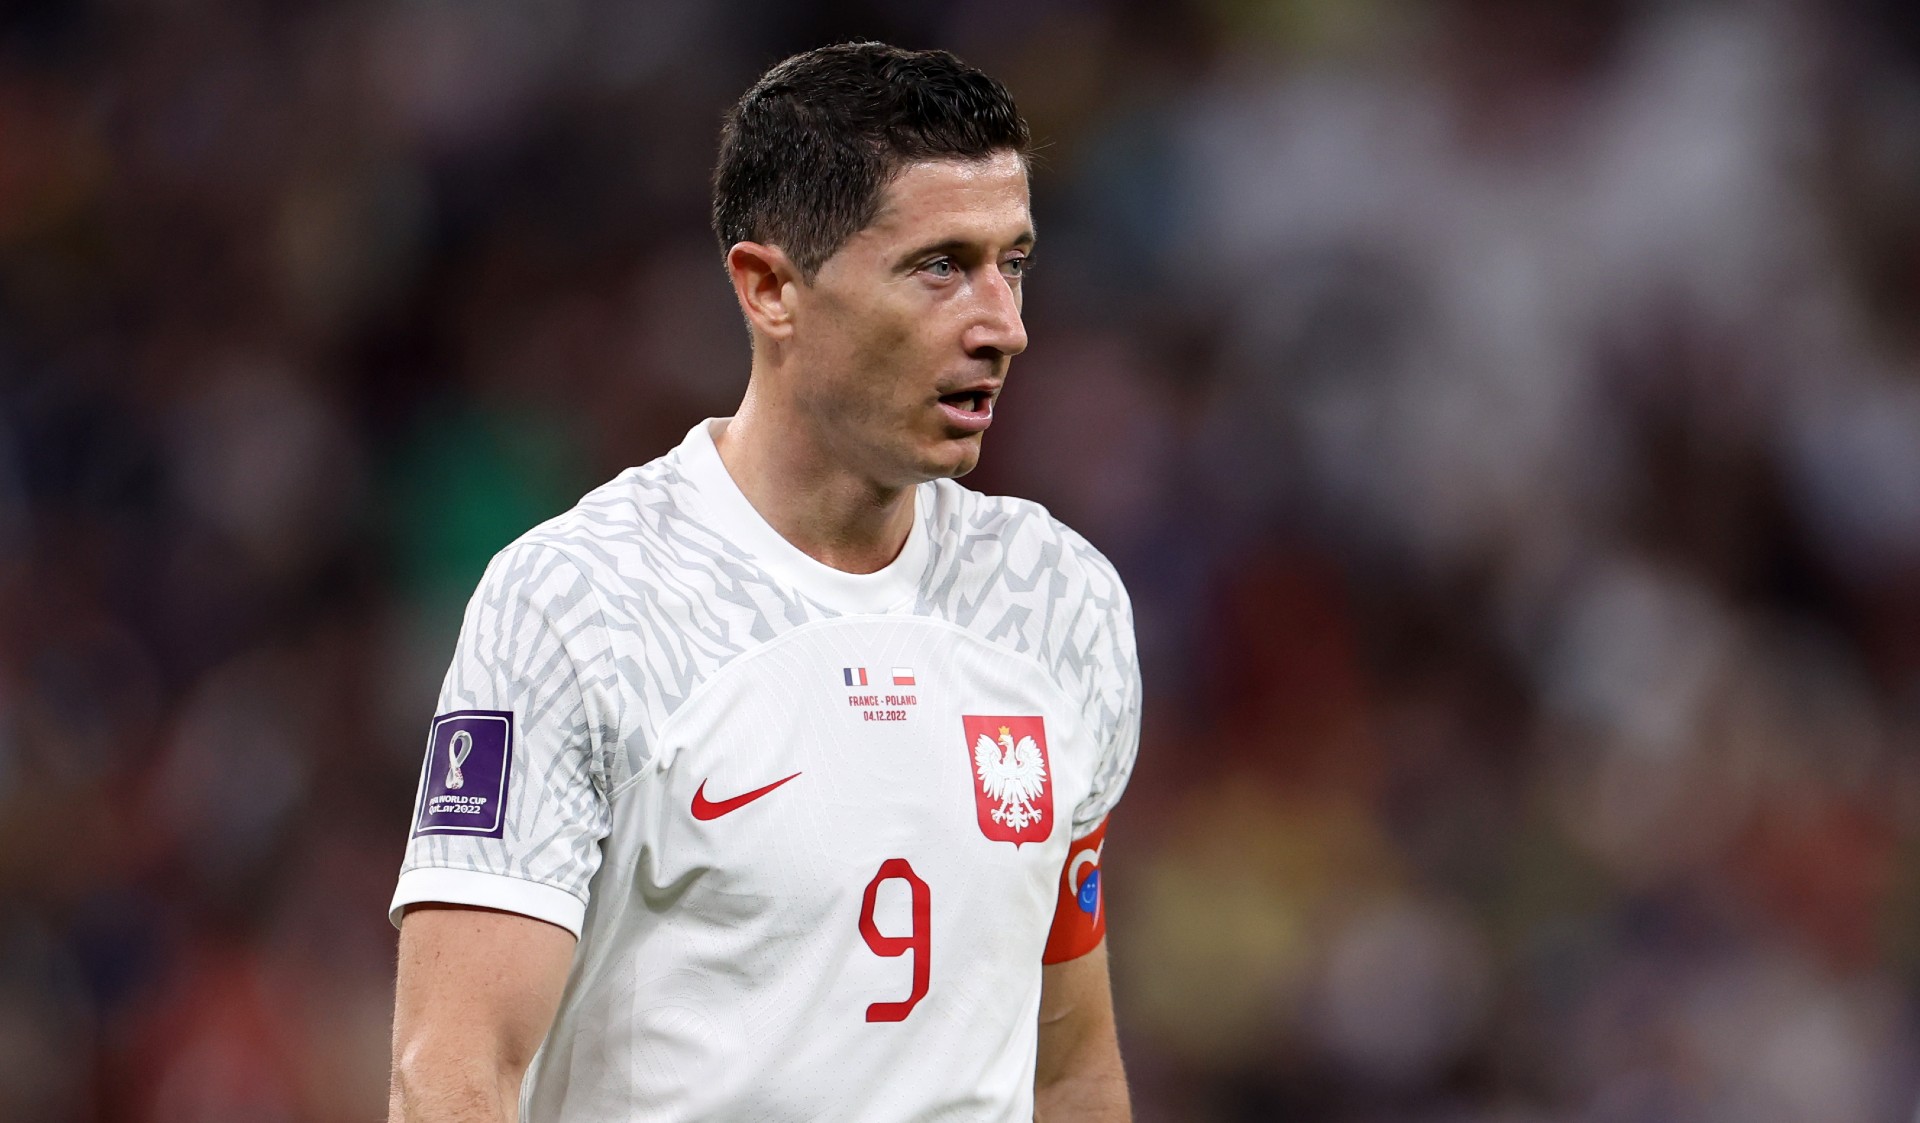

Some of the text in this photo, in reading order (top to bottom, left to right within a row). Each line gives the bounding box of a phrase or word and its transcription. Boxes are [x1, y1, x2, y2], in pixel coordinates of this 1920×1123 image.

[849, 696, 879, 706] FRANCE
[885, 695, 916, 706] POLAND
[863, 710, 906, 721] 04.12.2022
[439, 795, 468, 804] WORLD
[469, 797, 487, 805] CUP
[858, 858, 931, 1022] 9
